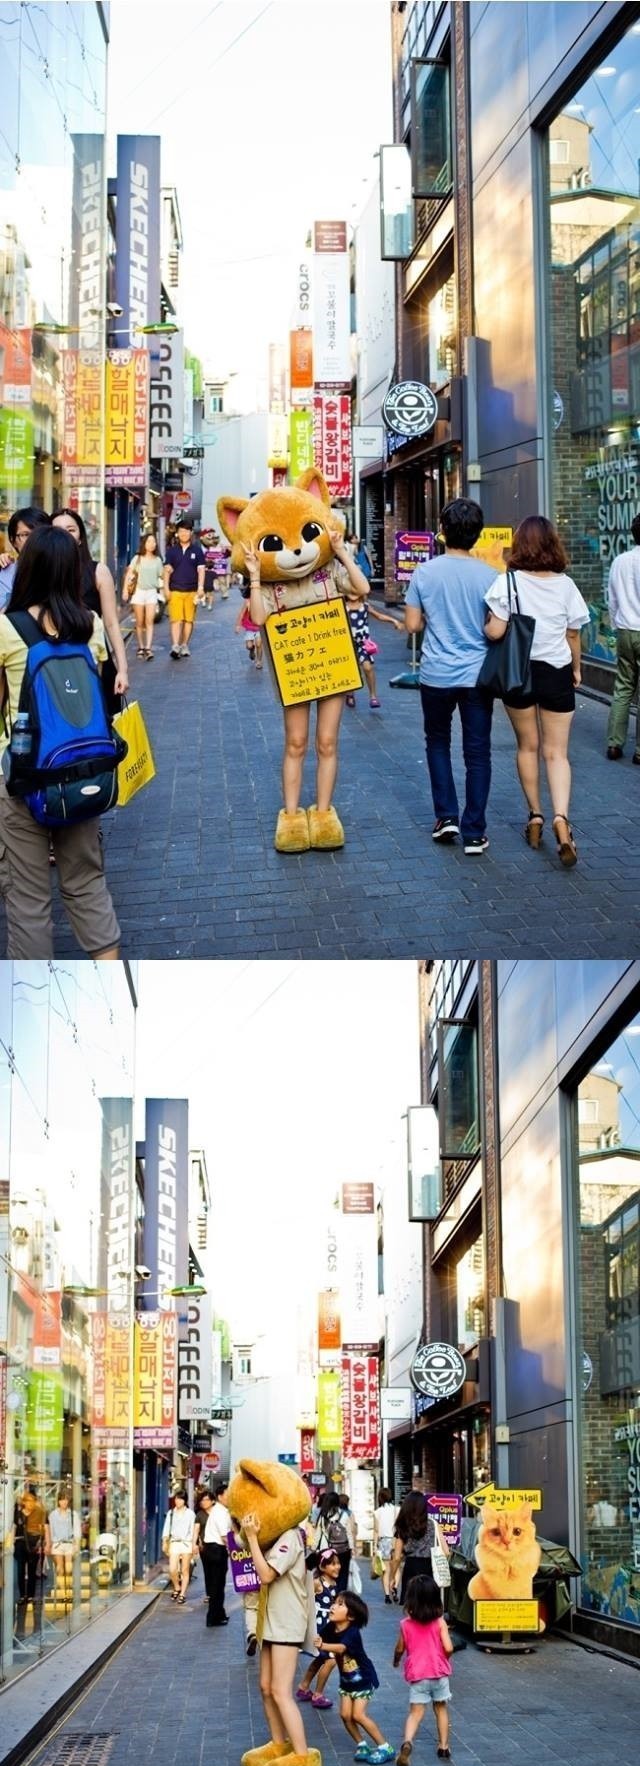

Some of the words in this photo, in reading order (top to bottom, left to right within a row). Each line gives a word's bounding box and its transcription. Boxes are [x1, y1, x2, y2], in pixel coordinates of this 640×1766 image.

[299, 263, 310, 311] crocs
[150, 337, 172, 438] OFFEE
[597, 471, 638, 502] YOUR
[290, 613, 317, 629] 고양이
[319, 608, 340, 620] 카페
[274, 639, 289, 651] CAT
[290, 636, 307, 648] cafe
[313, 629, 332, 642] Drink
[332, 627, 347, 638] free
[178, 1296, 201, 1400] OFFEE
[231, 1548, 252, 1563] Qplu
